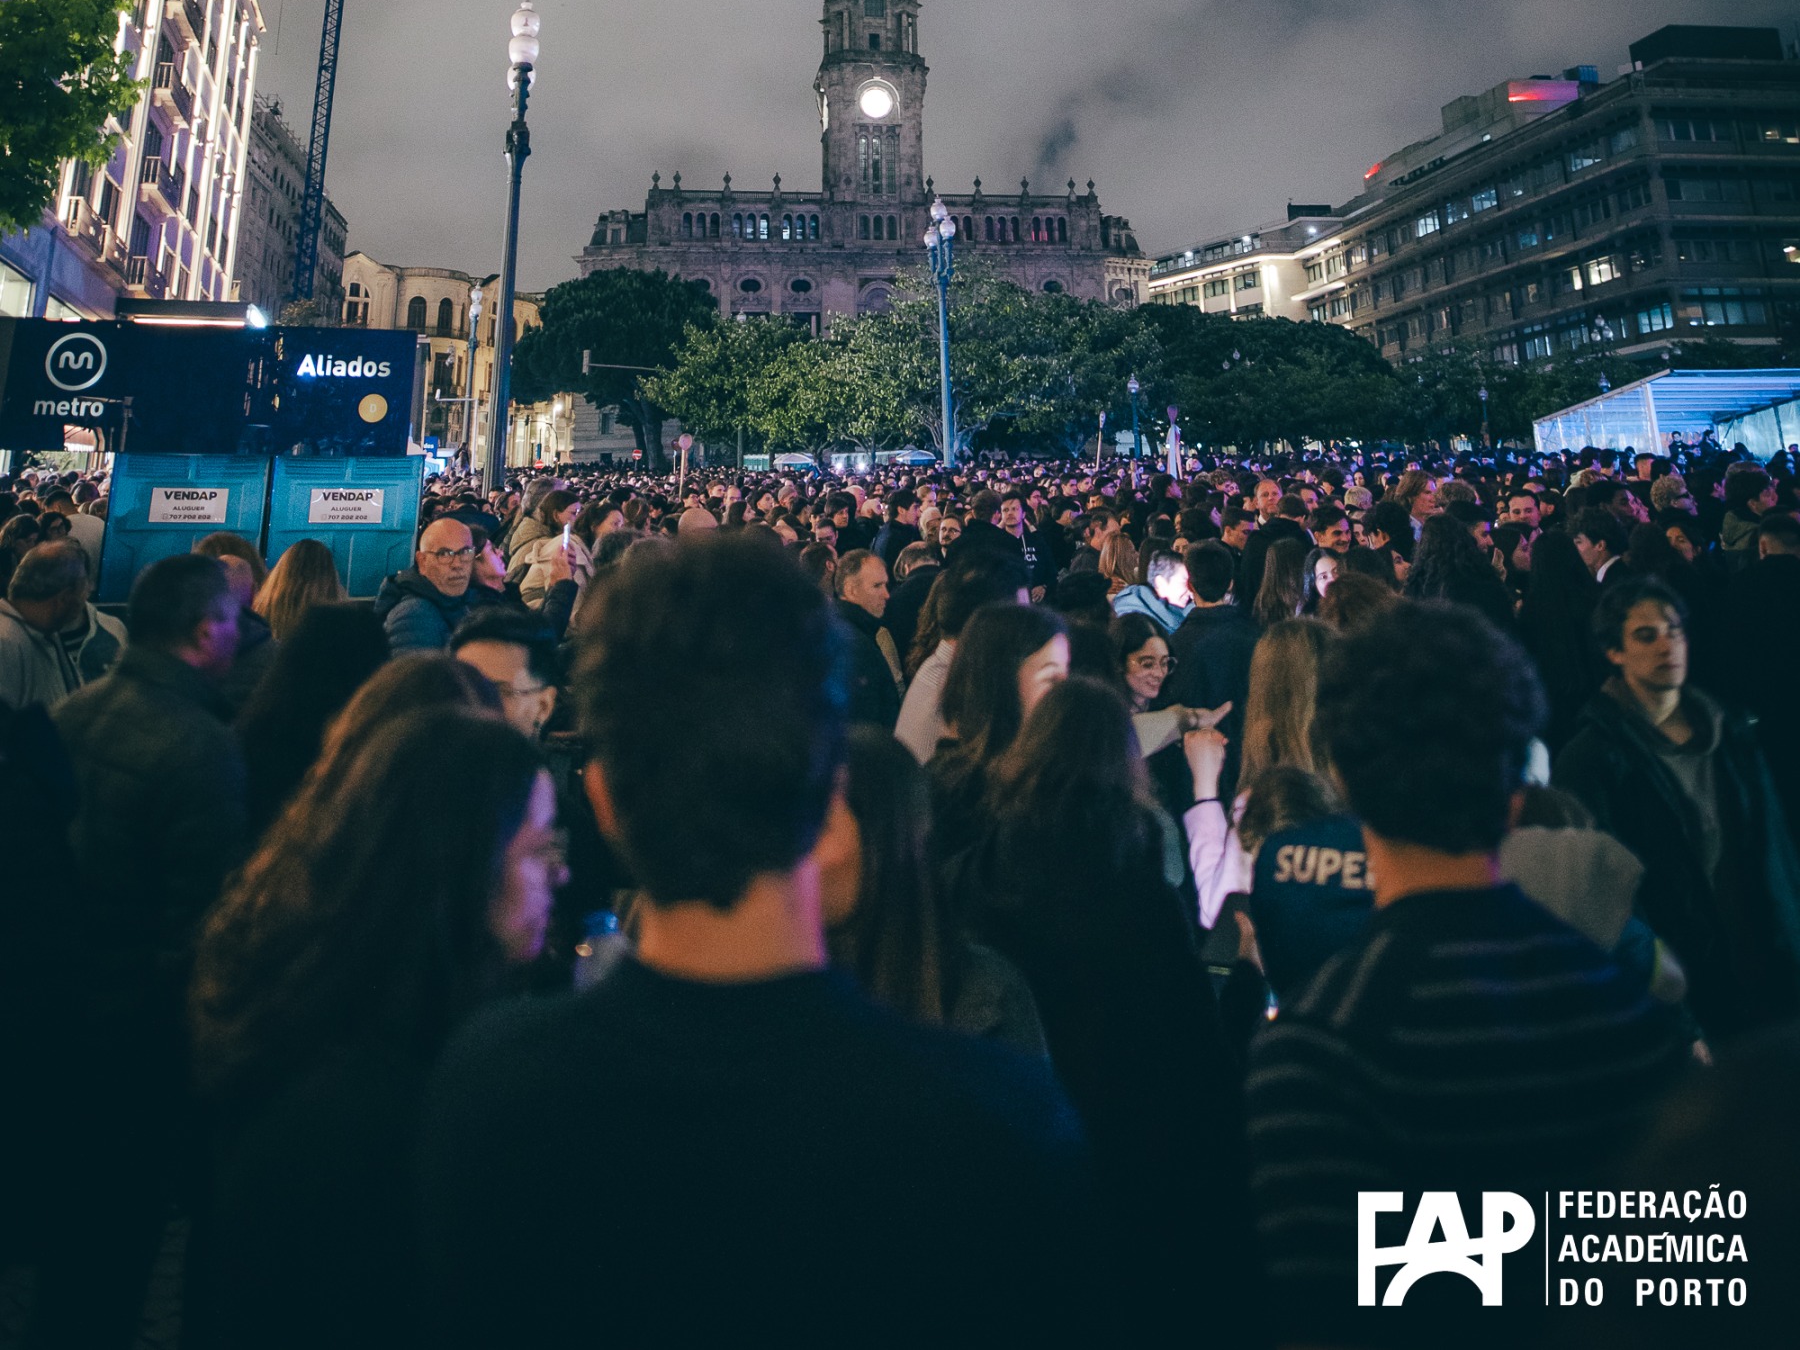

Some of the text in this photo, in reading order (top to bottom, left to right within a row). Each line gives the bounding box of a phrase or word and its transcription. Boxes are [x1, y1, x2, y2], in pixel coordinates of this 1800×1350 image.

[296, 353, 391, 377] Aliados
[33, 397, 104, 417] metro
[369, 403, 377, 413] D
[164, 490, 217, 501] VENDAP
[322, 491, 373, 501] VENDAP
